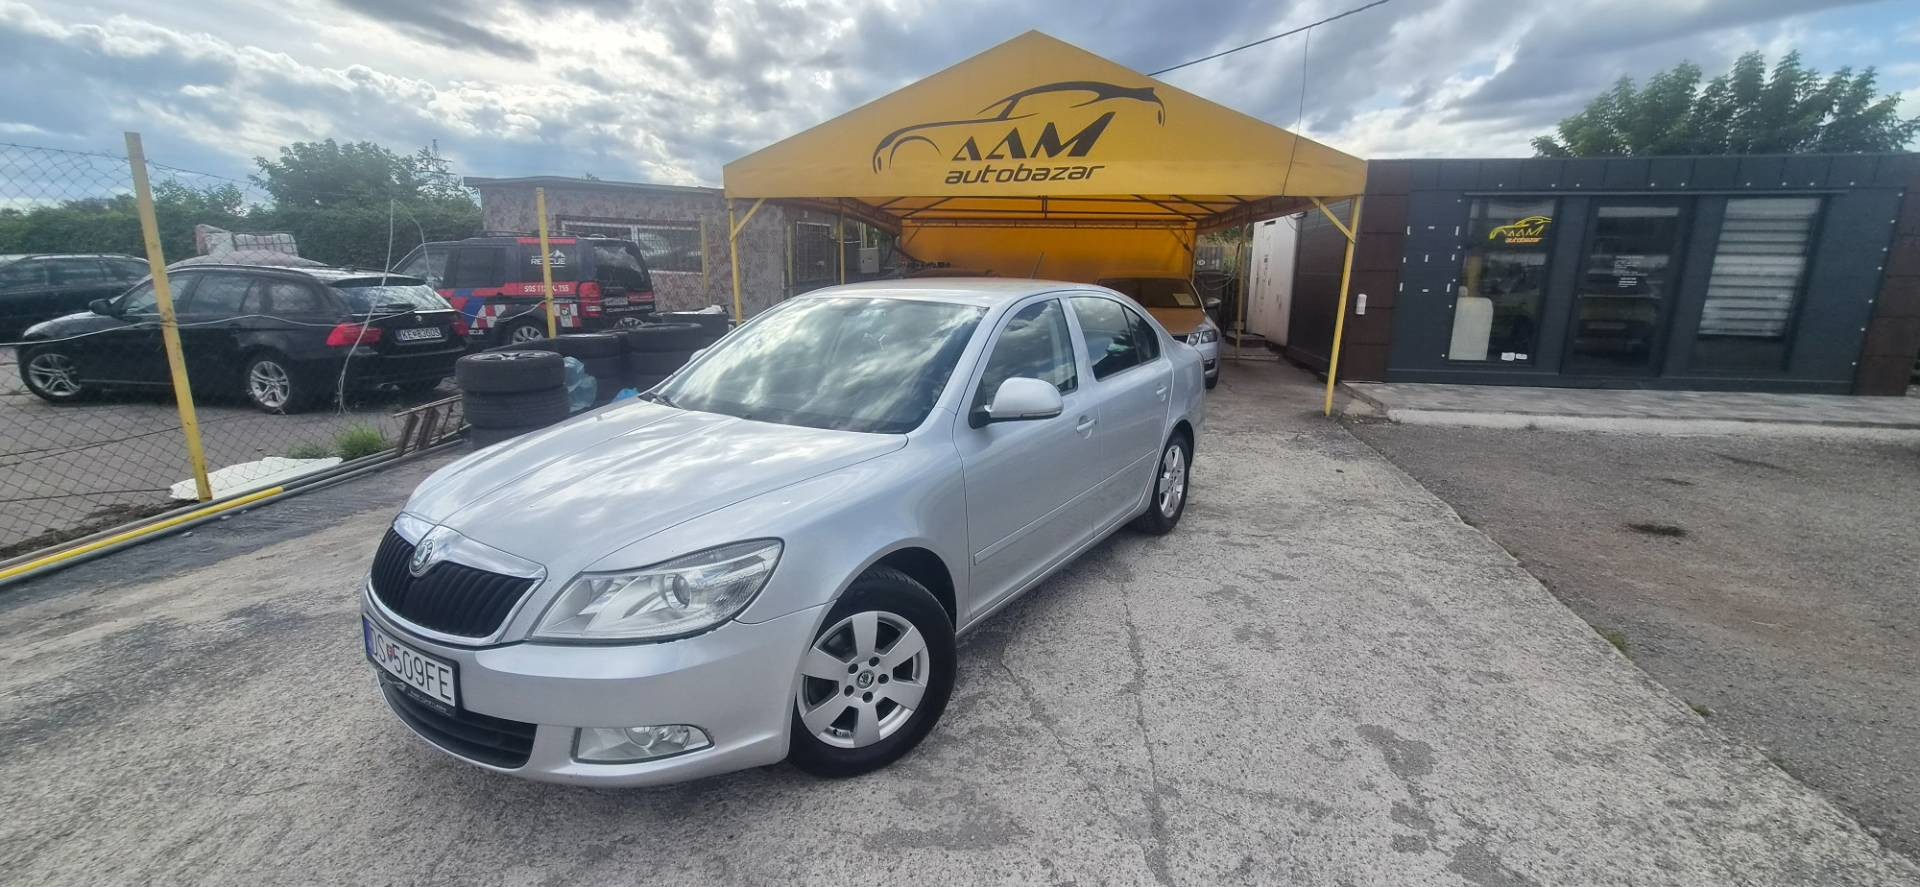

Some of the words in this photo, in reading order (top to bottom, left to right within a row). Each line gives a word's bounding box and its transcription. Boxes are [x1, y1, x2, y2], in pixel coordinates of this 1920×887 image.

[952, 111, 1116, 161] AAM
[944, 163, 1105, 184] autobazar
[530, 257, 566, 265] RECUE
